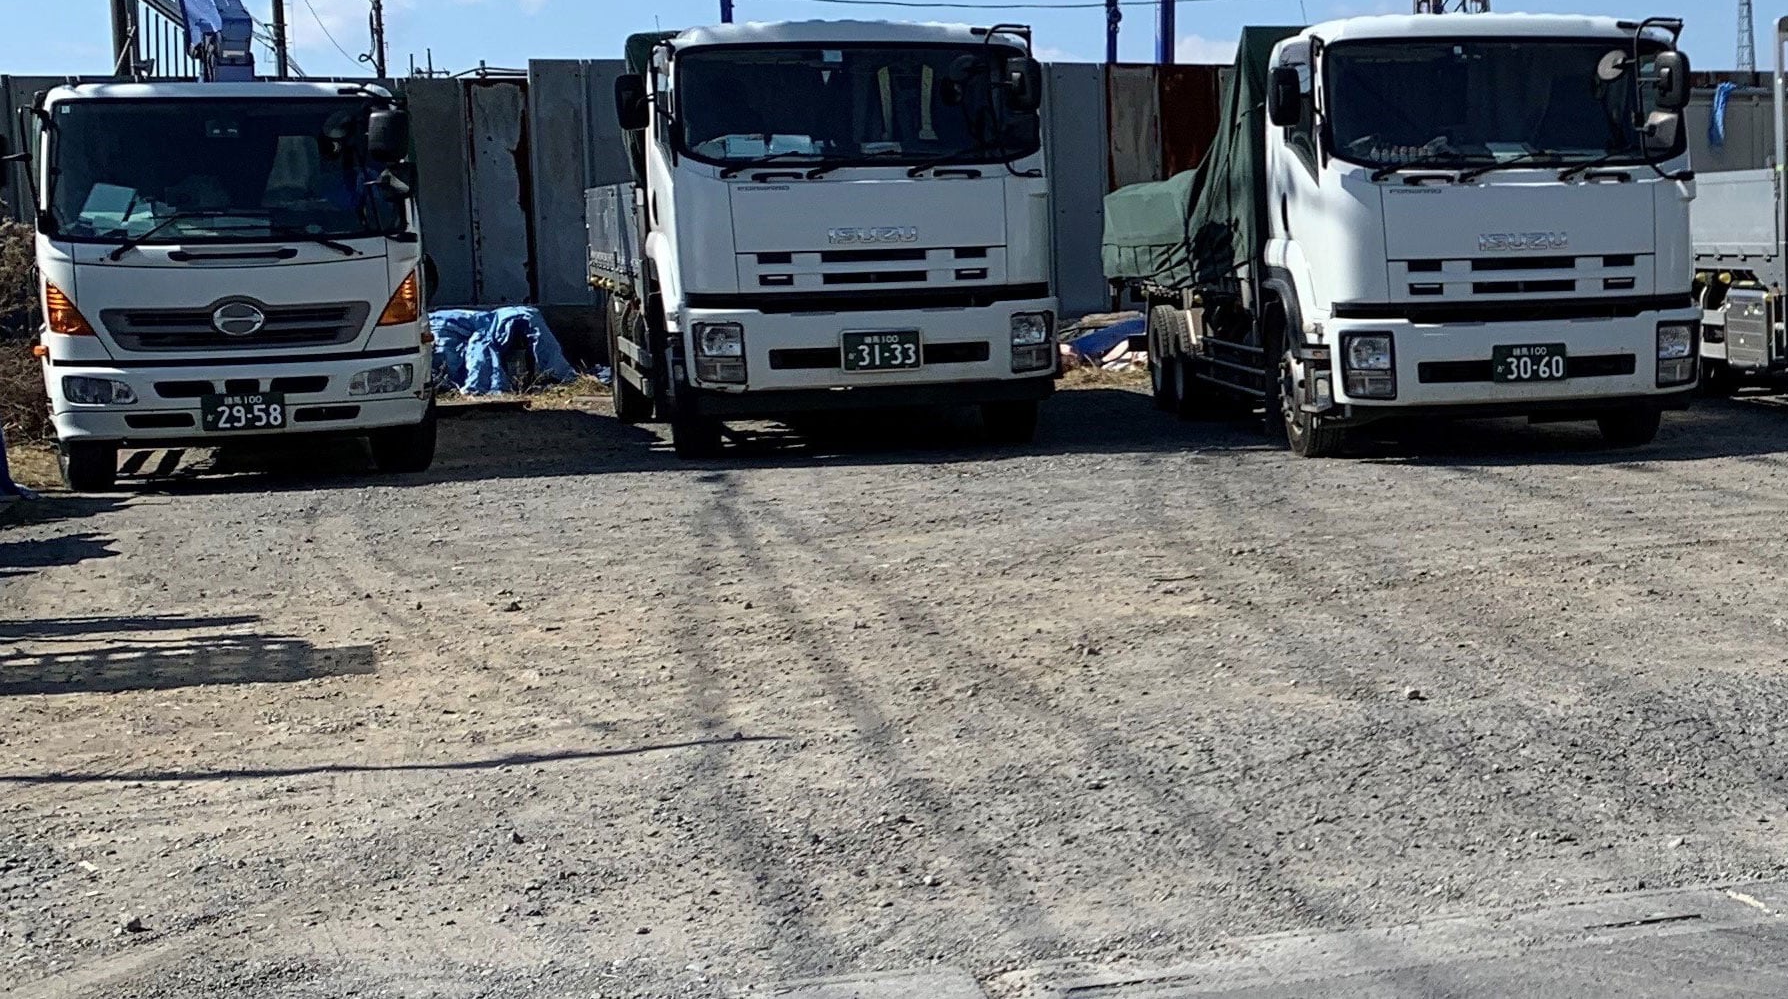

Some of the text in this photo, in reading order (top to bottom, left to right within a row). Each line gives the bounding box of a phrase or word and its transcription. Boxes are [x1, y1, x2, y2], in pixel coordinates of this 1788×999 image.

[828, 226, 918, 245] ISUZU
[1478, 232, 1568, 252] ISUZU
[857, 343, 917, 366] 31-33
[1531, 346, 1548, 356] 100
[1506, 356, 1564, 380] 30-60
[245, 395, 263, 404] 100
[217, 404, 282, 428] 29-58
